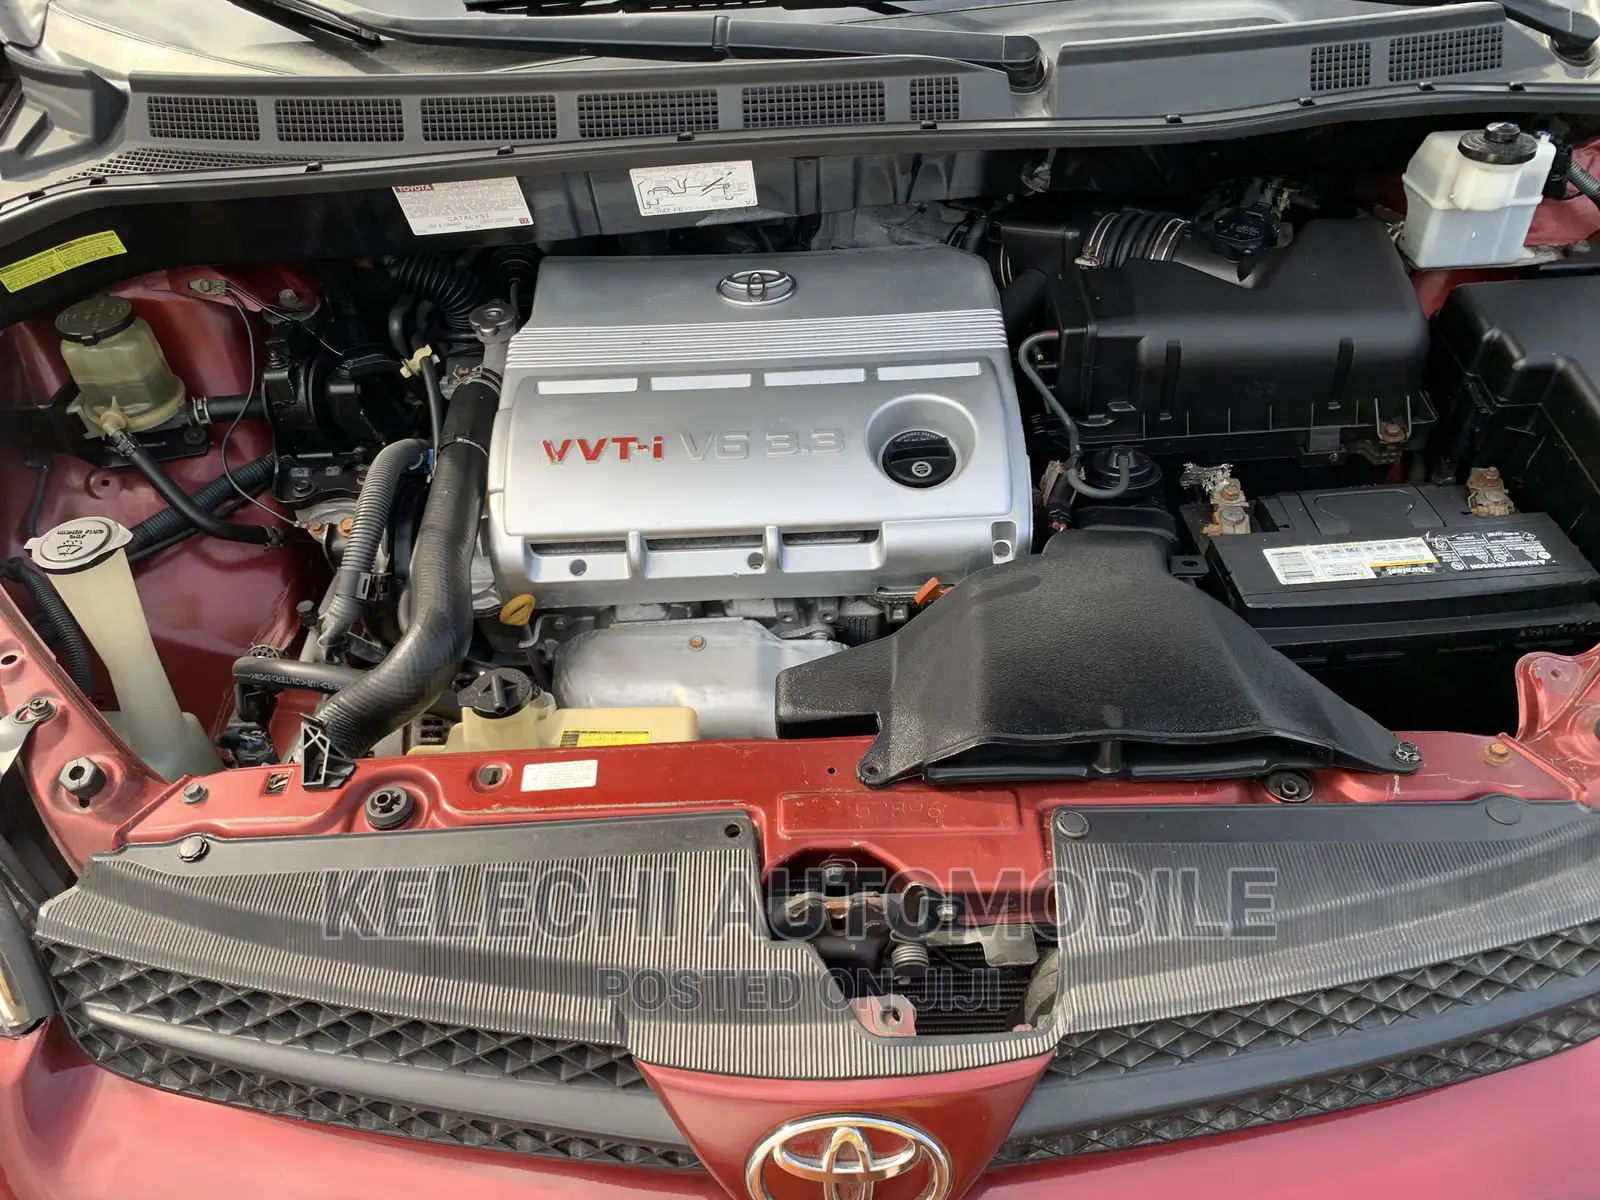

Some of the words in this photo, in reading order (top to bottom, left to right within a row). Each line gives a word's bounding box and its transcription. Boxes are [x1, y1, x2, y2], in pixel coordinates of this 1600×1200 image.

[397, 184, 432, 192] TOYOTA
[447, 213, 490, 222] CATALYST
[541, 435, 664, 465] VVT-i
[680, 431, 750, 461] V6
[766, 428, 844, 458] 3.3
[1387, 566, 1431, 576] Duralast
